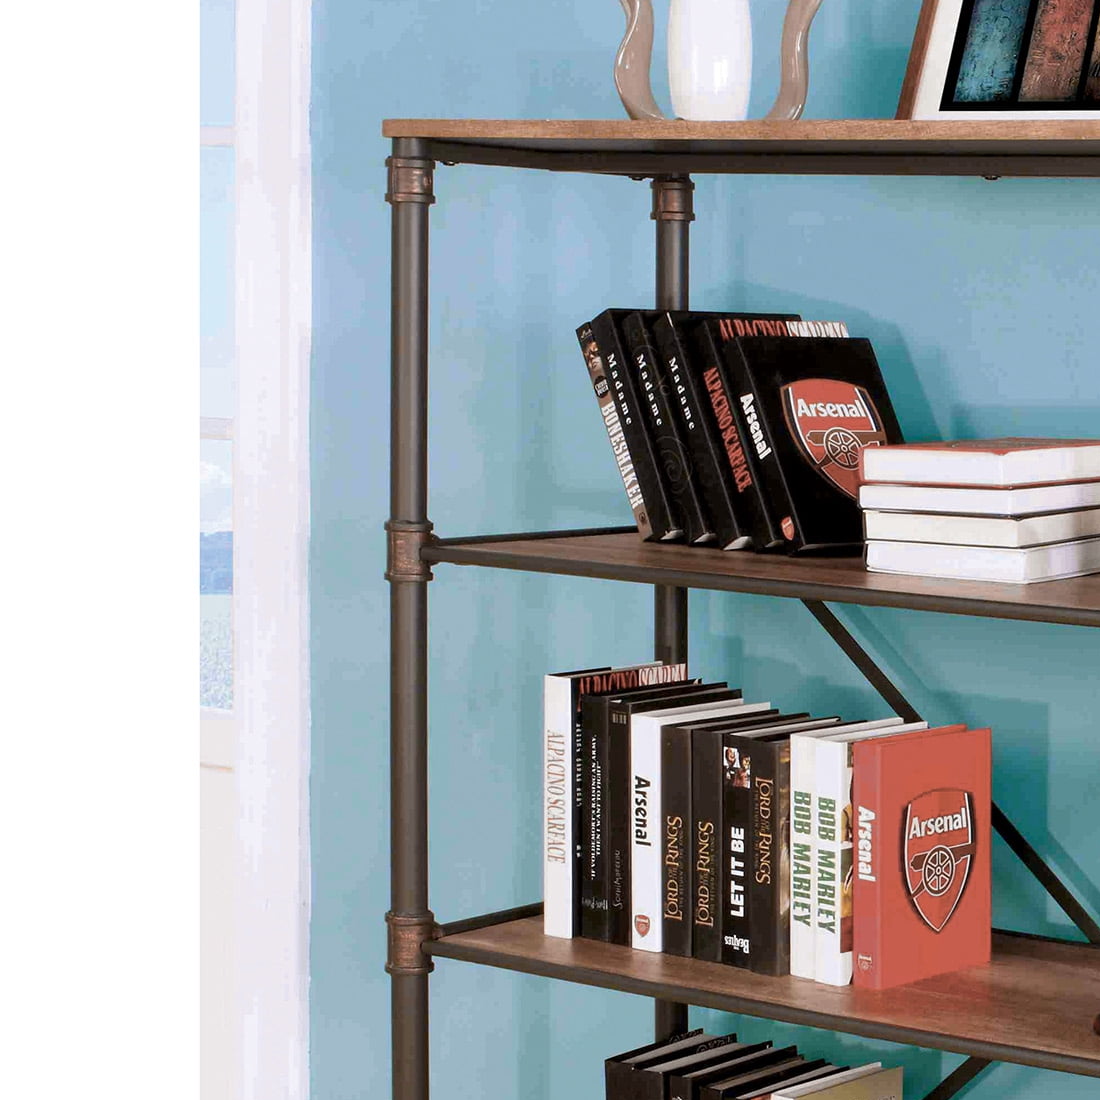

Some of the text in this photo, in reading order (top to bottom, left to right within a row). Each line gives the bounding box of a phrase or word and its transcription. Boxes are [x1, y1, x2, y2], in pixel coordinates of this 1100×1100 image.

[607, 353, 632, 425] Madame
[637, 353, 663, 426] Madame
[668, 356, 695, 430] Madame
[797, 398, 868, 418] Arsenal
[601, 400, 644, 510] BONESHAKER
[721, 425, 752, 493] SCARFACE
[739, 392, 772, 460] Arsenal
[546, 797, 566, 864] SCARFACE
[635, 775, 652, 847] Arsenal
[755, 777, 774, 819] LORD
[908, 807, 966, 840] Arsenal
[665, 815, 683, 867] RINGS
[697, 821, 714, 872] RINGS
[730, 826, 745, 917] LET IT BE
[755, 832, 772, 884] RINGS
[793, 790, 811, 927] BOB MARLEY
[817, 796, 836, 935] BOB MARLEY
[857, 805, 877, 883] Arsenal
[664, 879, 683, 921] LORD
[695, 885, 714, 927] LORD
